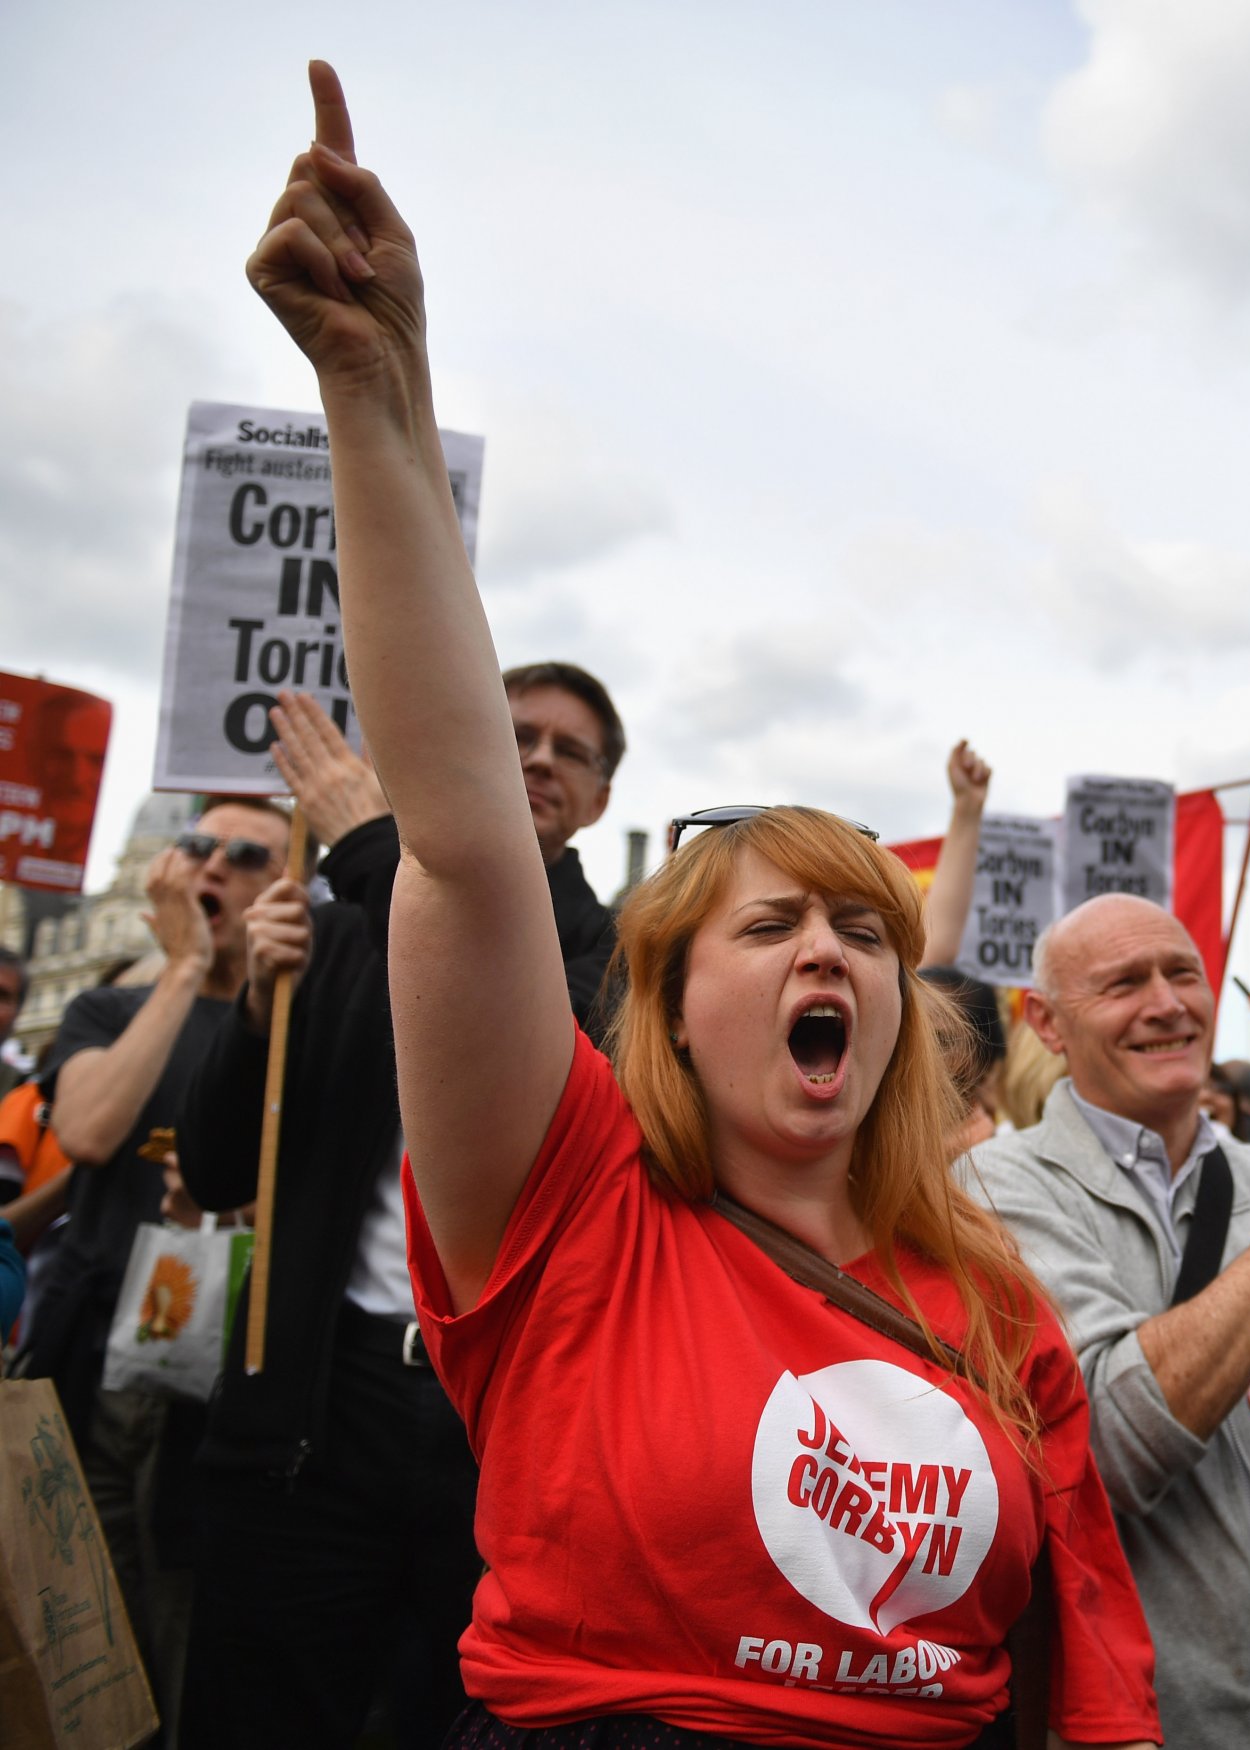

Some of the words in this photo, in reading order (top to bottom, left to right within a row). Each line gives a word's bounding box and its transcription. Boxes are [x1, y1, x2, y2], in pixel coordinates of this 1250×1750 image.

[204, 450, 255, 478] Fight
[1101, 839, 1135, 866] IN
[993, 880, 1023, 906] IN
[734, 1636, 823, 1681] FOR
